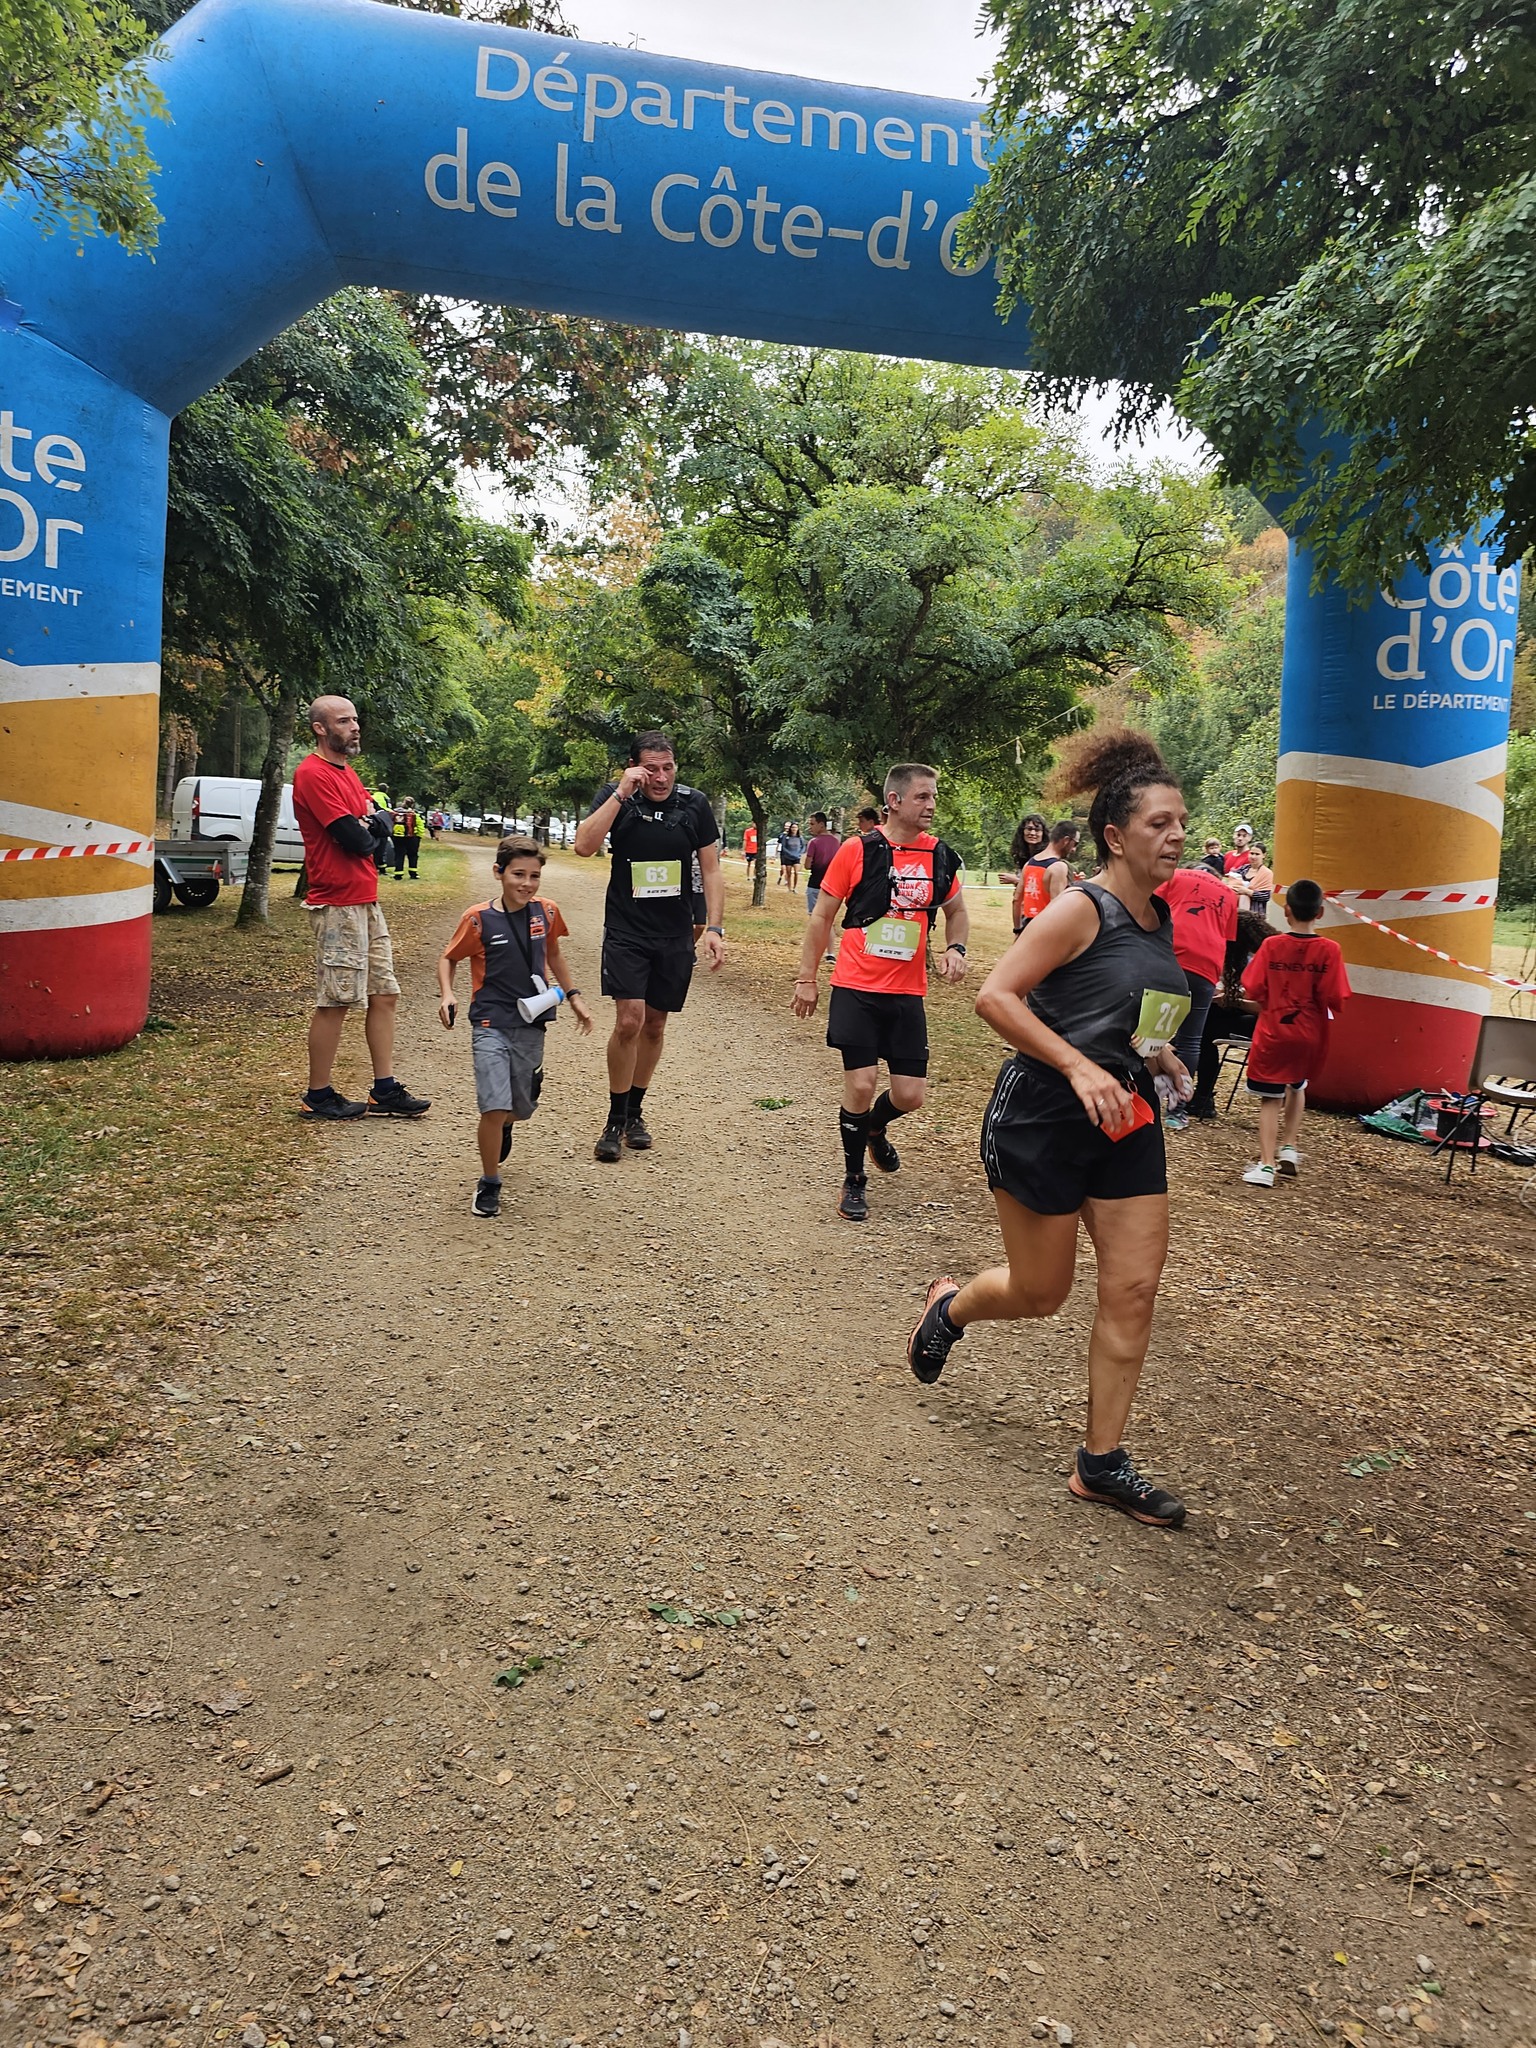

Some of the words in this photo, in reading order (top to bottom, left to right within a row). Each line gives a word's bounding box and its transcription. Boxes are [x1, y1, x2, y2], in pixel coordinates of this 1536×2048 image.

[475, 45, 995, 171] Département
[424, 127, 521, 218] de
[555, 143, 622, 234] la
[651, 166, 1004, 279] Côte-d'O
[0, 577, 83, 607] EMENT
[1376, 610, 1513, 683] d'Or
[1373, 694, 1397, 710] LE
[645, 866, 668, 883] 63
[880, 923, 907, 943] 56
[1154, 1002, 1180, 1033] 21
